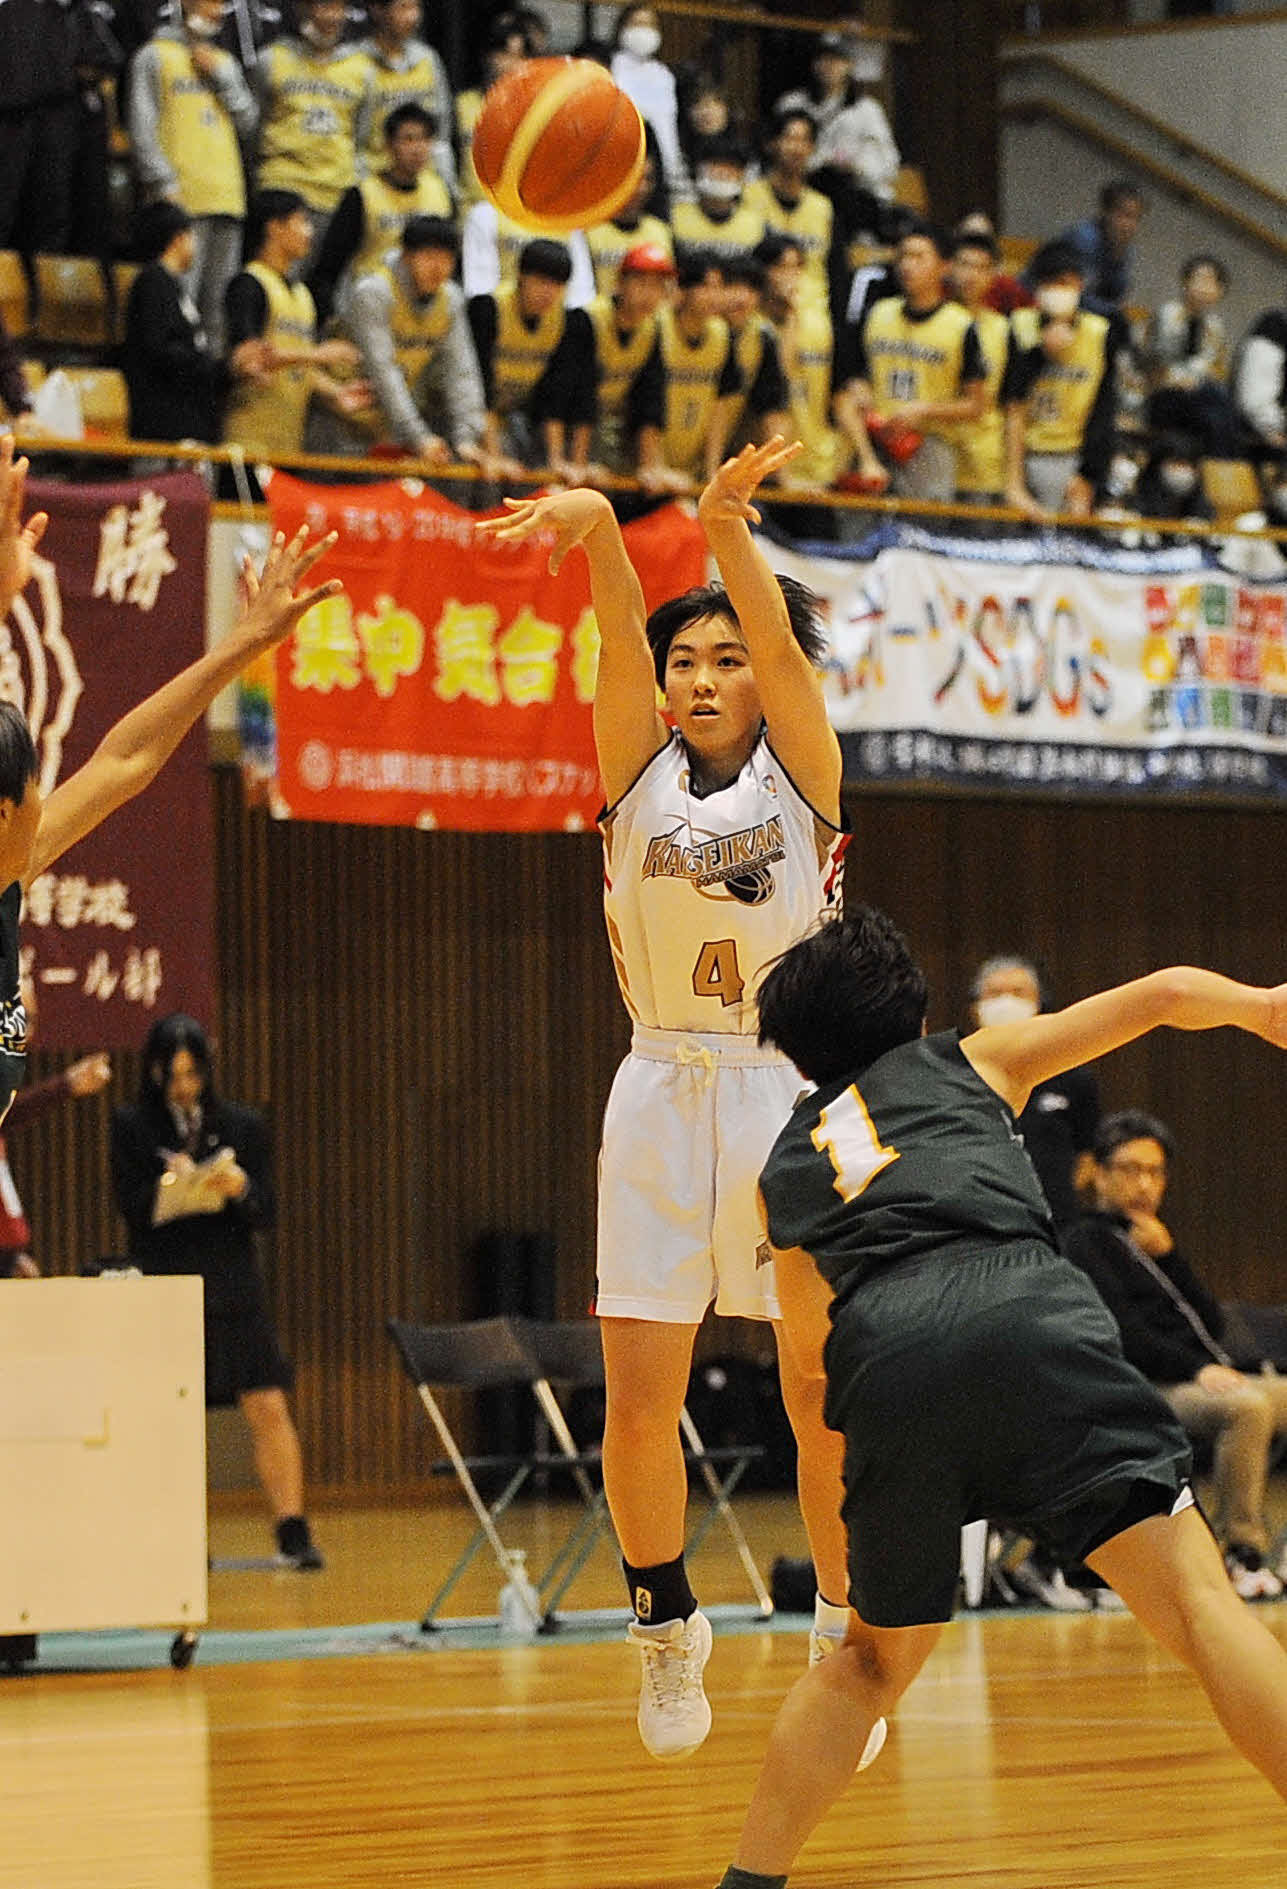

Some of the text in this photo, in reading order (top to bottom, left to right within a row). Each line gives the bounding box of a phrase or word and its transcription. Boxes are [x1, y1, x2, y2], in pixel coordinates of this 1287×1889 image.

[92, 489, 178, 611] 勝
[692, 939, 744, 1008] 4
[811, 1083, 901, 1205] 1
